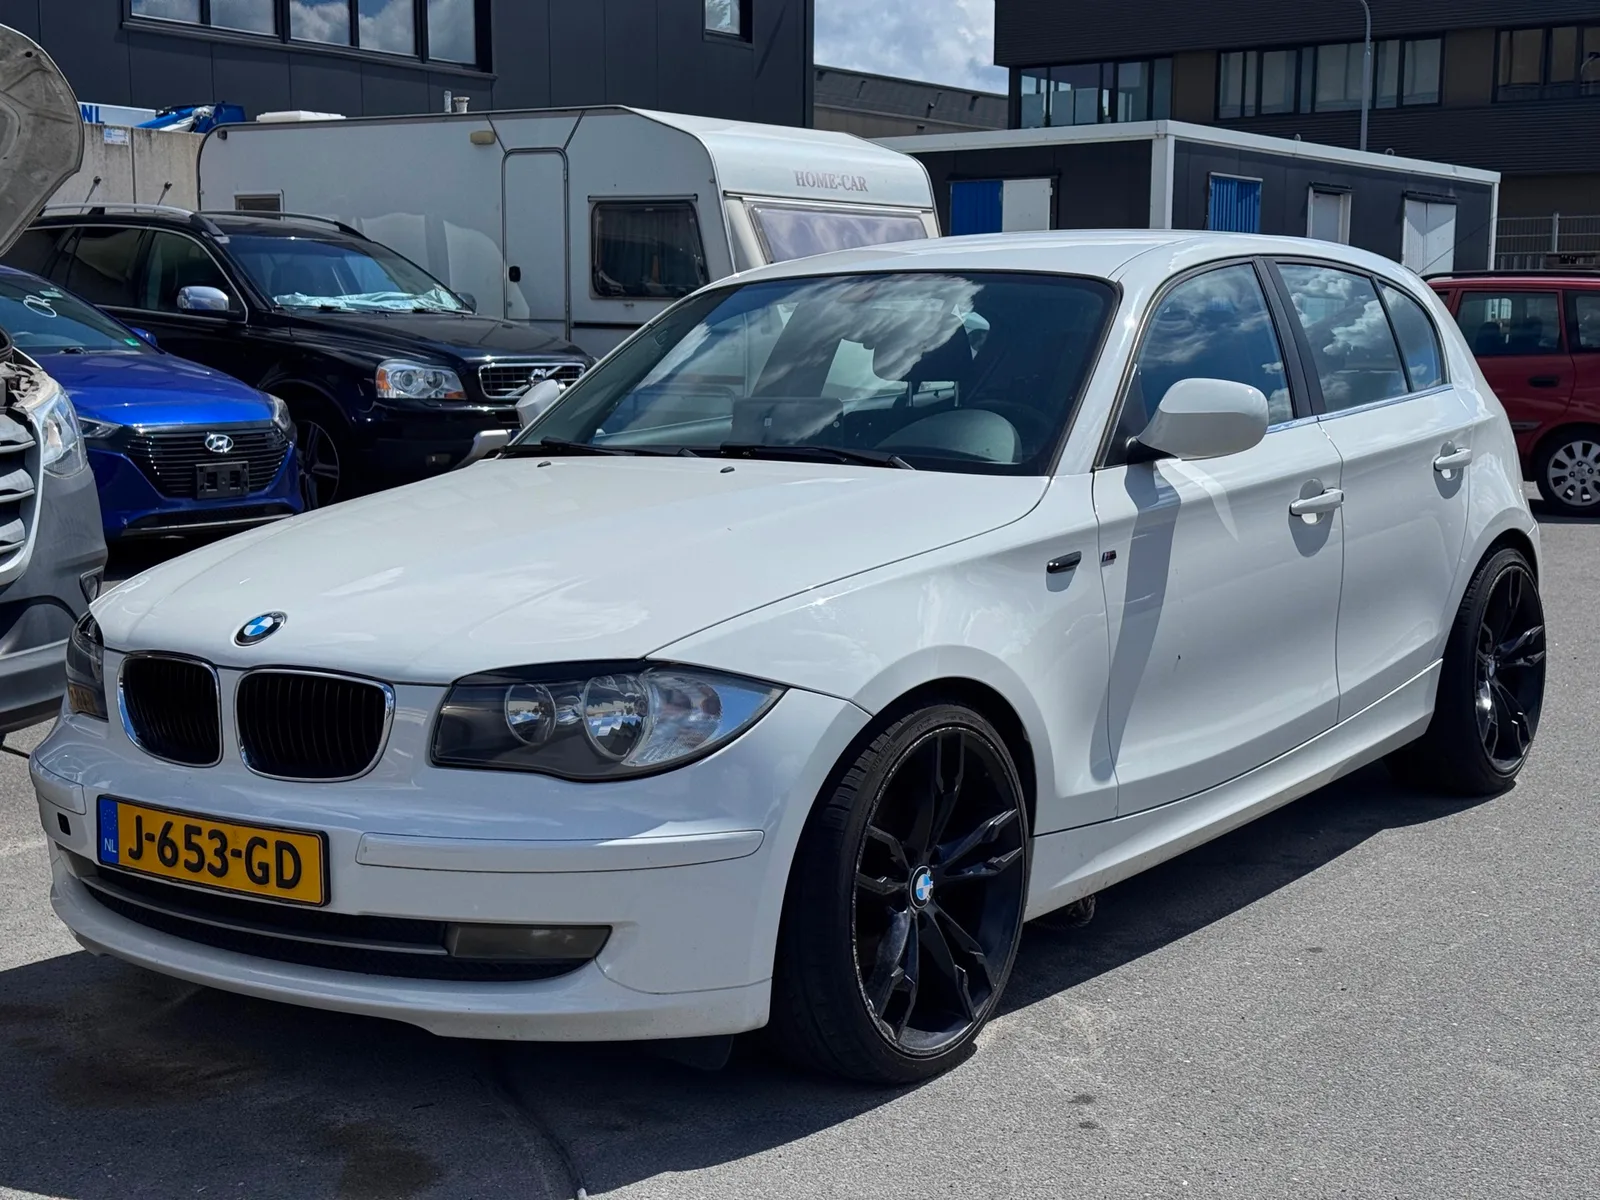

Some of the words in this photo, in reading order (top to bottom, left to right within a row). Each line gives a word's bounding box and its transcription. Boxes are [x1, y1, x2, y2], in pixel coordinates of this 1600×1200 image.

[794, 170, 868, 192] HOME-CAR
[104, 837, 117, 854] NL
[128, 815, 302, 890] J-653-GD
